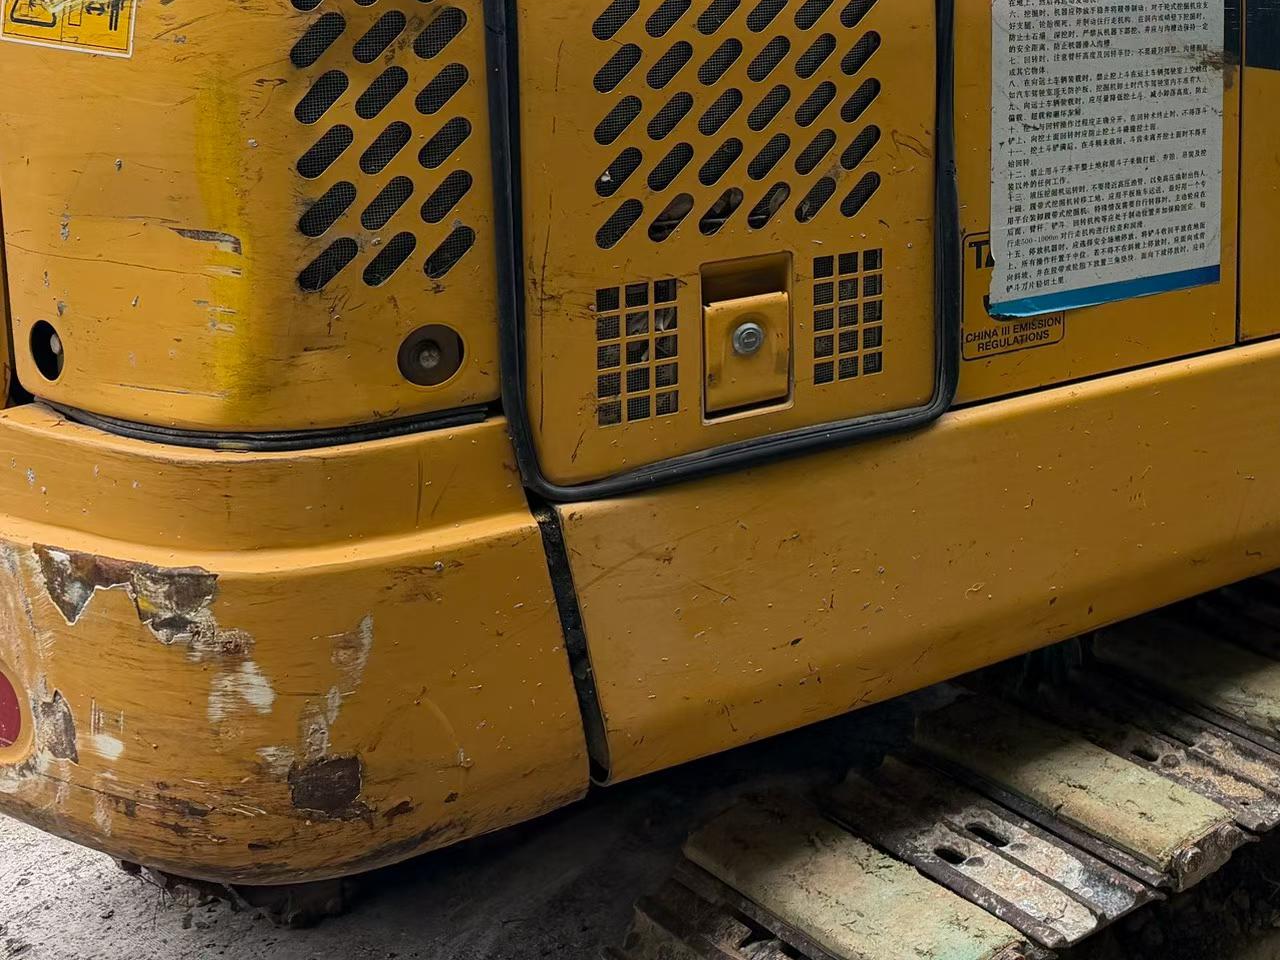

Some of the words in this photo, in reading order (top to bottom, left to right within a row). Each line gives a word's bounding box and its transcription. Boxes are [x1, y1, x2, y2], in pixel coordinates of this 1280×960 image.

[965, 329, 998, 343] CHINA
[1001, 326, 1010, 335] III
[1013, 316, 1061, 333] EMISSION
[977, 330, 1050, 352] REGULATIONS
